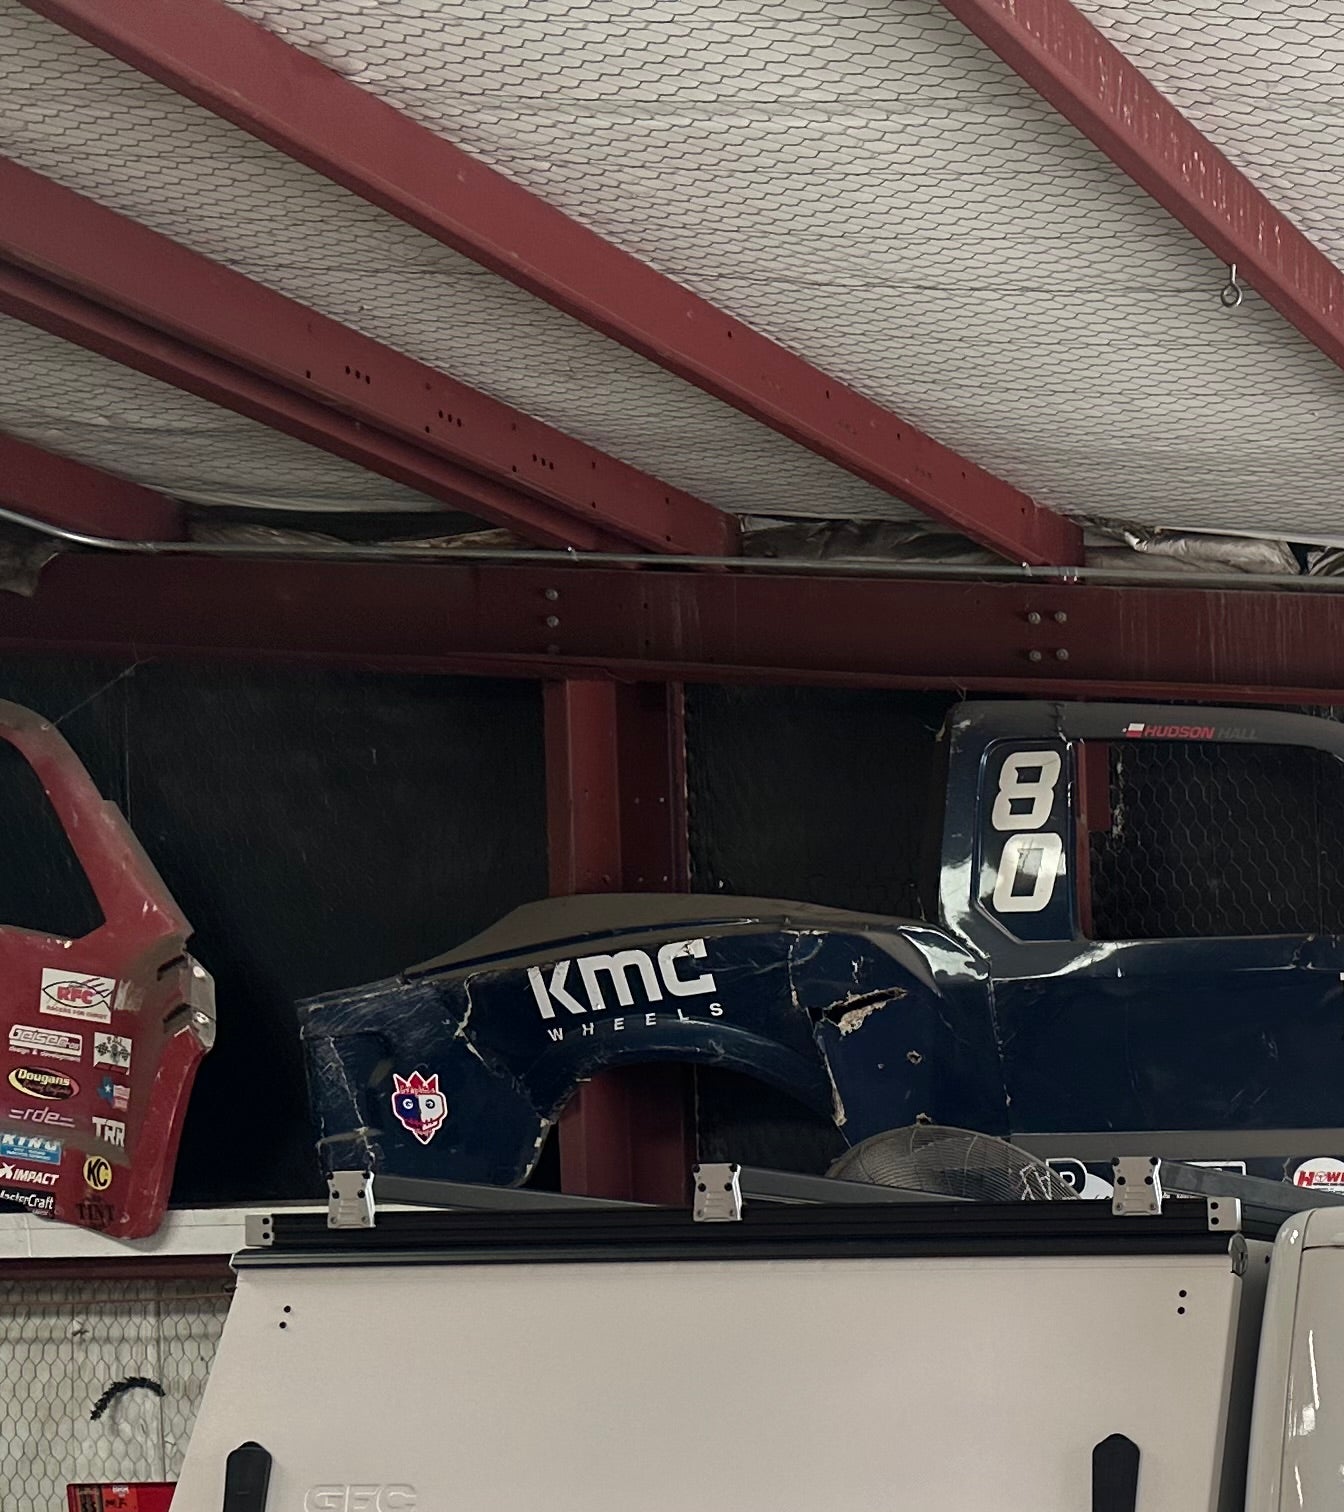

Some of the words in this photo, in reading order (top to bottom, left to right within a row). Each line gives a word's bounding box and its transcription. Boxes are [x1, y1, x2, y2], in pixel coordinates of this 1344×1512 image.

[1144, 725, 1214, 738] HUDSON
[1217, 727, 1257, 739] HALL
[992, 750, 1062, 912] 80
[57, 986, 95, 1005] RFC
[547, 1003, 724, 1041] WHEELS
[18, 1068, 70, 1086] Dougans
[87, 1158, 108, 1187] KC
